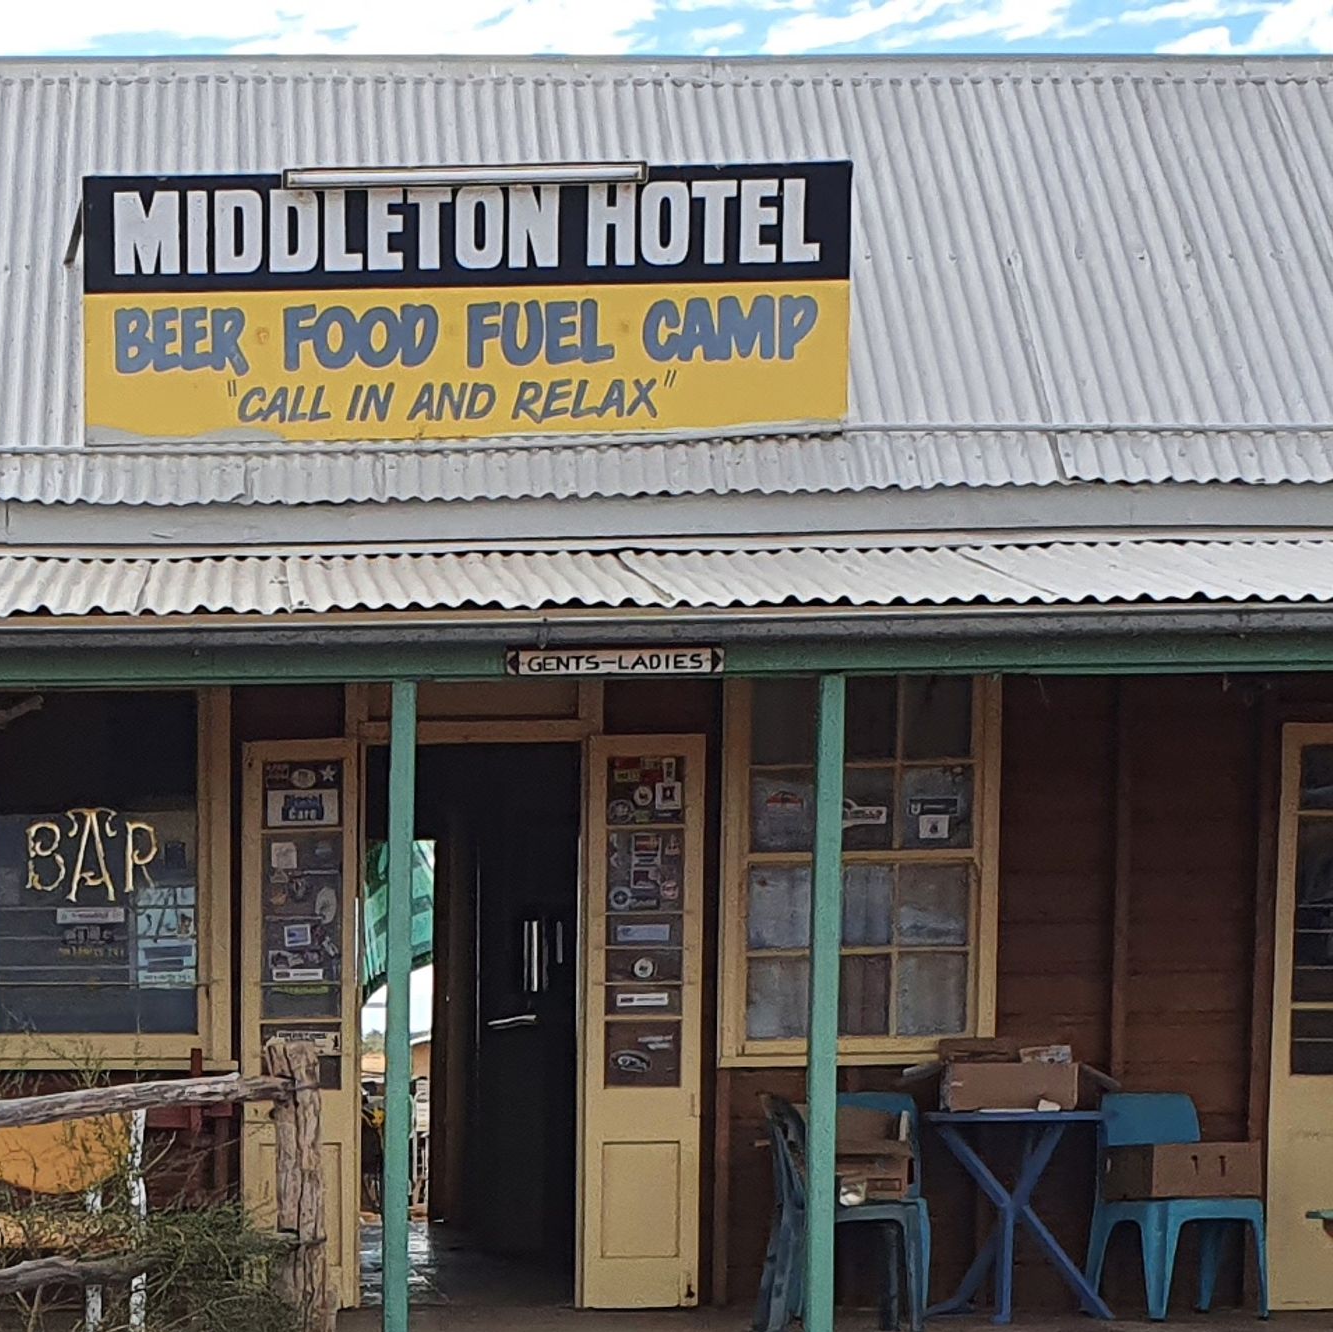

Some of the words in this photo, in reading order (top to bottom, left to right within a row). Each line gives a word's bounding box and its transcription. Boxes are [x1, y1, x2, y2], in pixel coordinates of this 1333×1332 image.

[112, 184, 561, 276] MIDDLETON
[585, 178, 821, 267] HOTEL
[113, 306, 250, 377] BEER
[282, 303, 440, 373] FOOD
[465, 298, 616, 369] FUEL
[642, 294, 819, 362] CAMP
[345, 382, 396, 422] IN
[405, 381, 497, 421] AND
[25, 807, 158, 903] BAR
